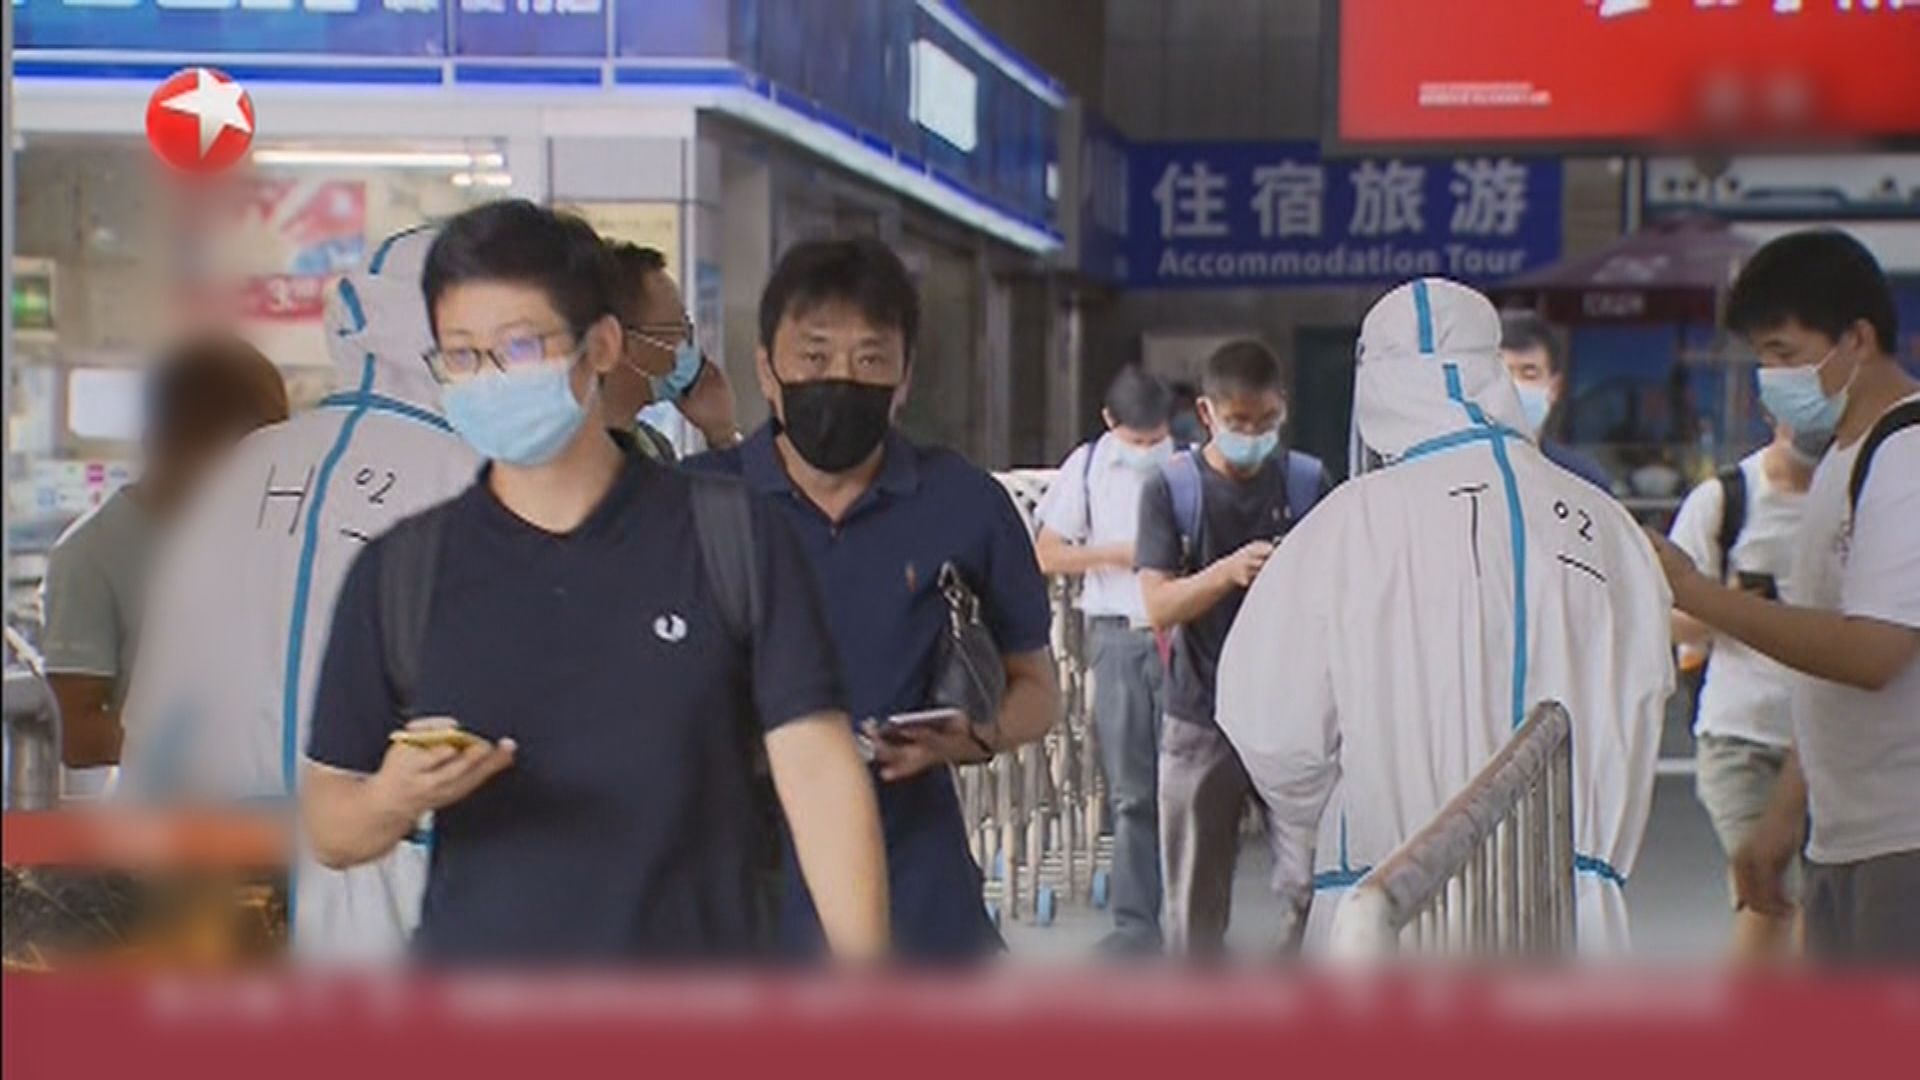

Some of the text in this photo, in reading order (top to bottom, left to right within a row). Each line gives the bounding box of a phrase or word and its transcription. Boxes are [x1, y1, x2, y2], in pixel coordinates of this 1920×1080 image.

[1152, 159, 1527, 238] 住宿旅游
[1158, 244, 1526, 278] Accommodation Tour
[256, 464, 316, 535] H
[1448, 482, 1490, 579] T
